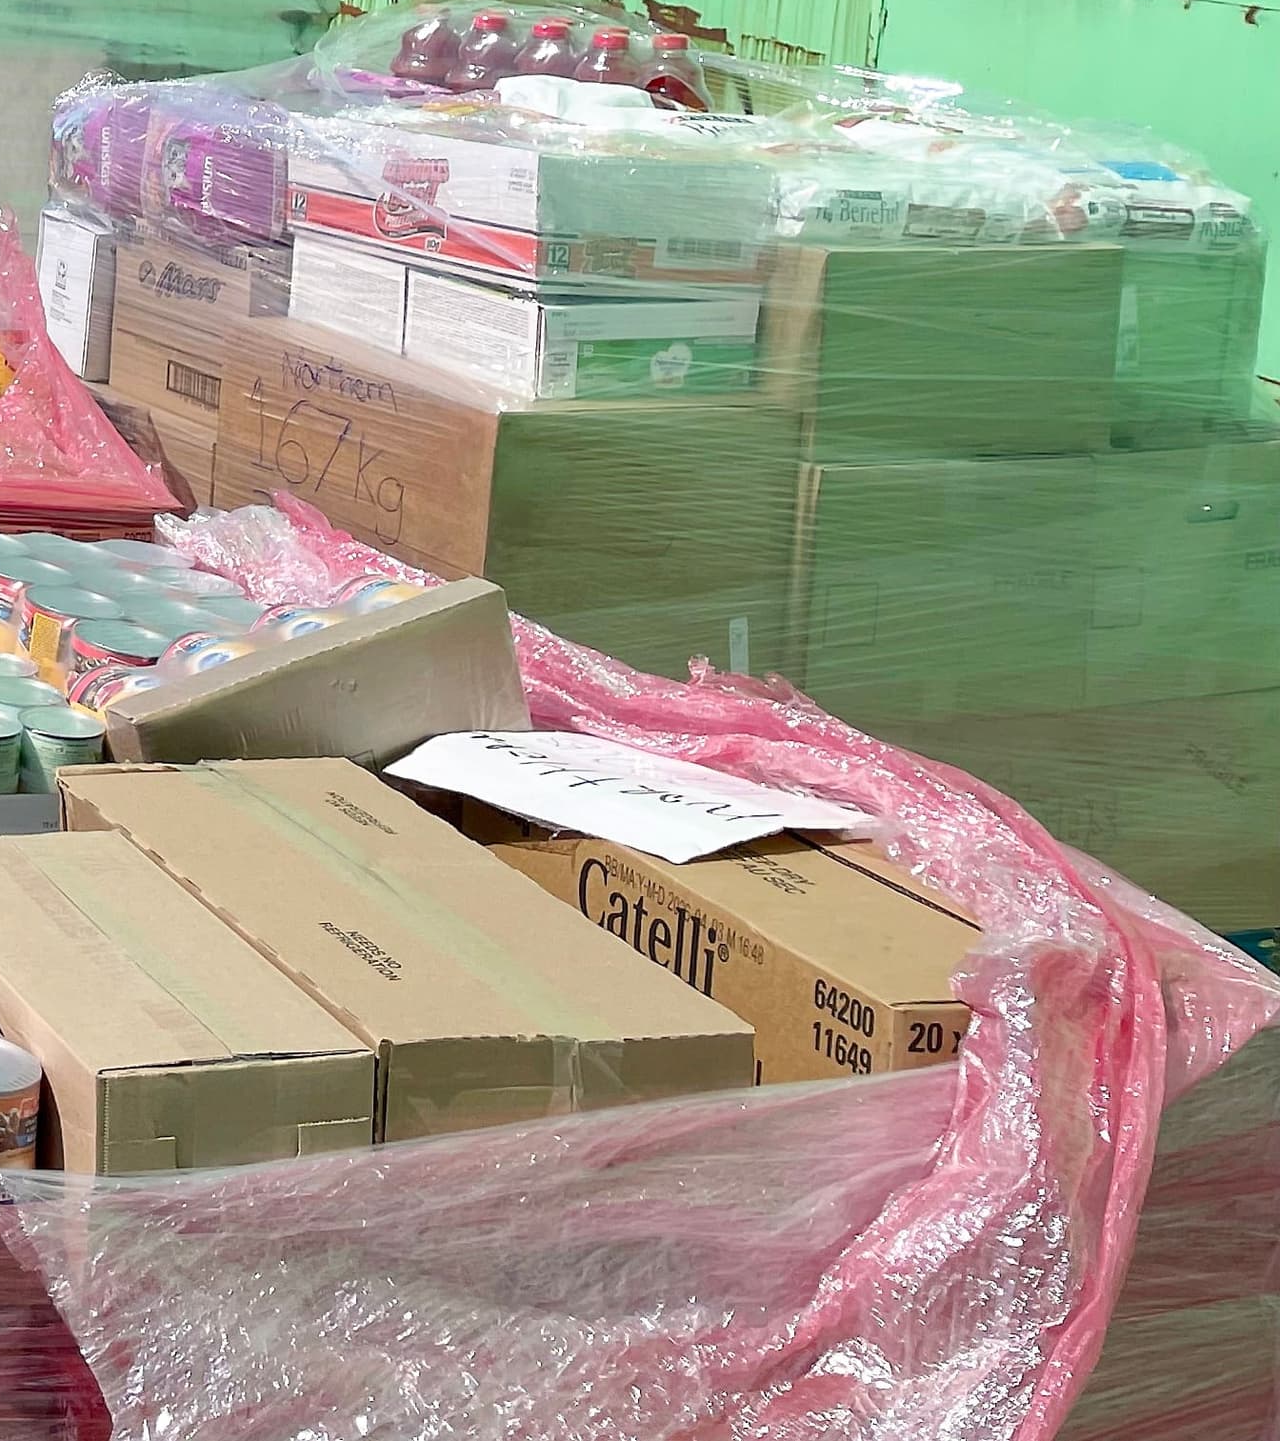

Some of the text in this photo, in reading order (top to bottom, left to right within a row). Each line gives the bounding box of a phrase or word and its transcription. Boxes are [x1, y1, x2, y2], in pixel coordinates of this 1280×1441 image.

[549, 246, 567, 264] 12
[248, 376, 352, 494] 167
[318, 921, 403, 982] REFRIGERATION
[346, 930, 403, 970] NEEDS NO
[579, 857, 715, 999] Catelli
[814, 978, 875, 1038] 64200
[813, 1021, 872, 1075] 11649
[908, 1022, 944, 1054] 20
